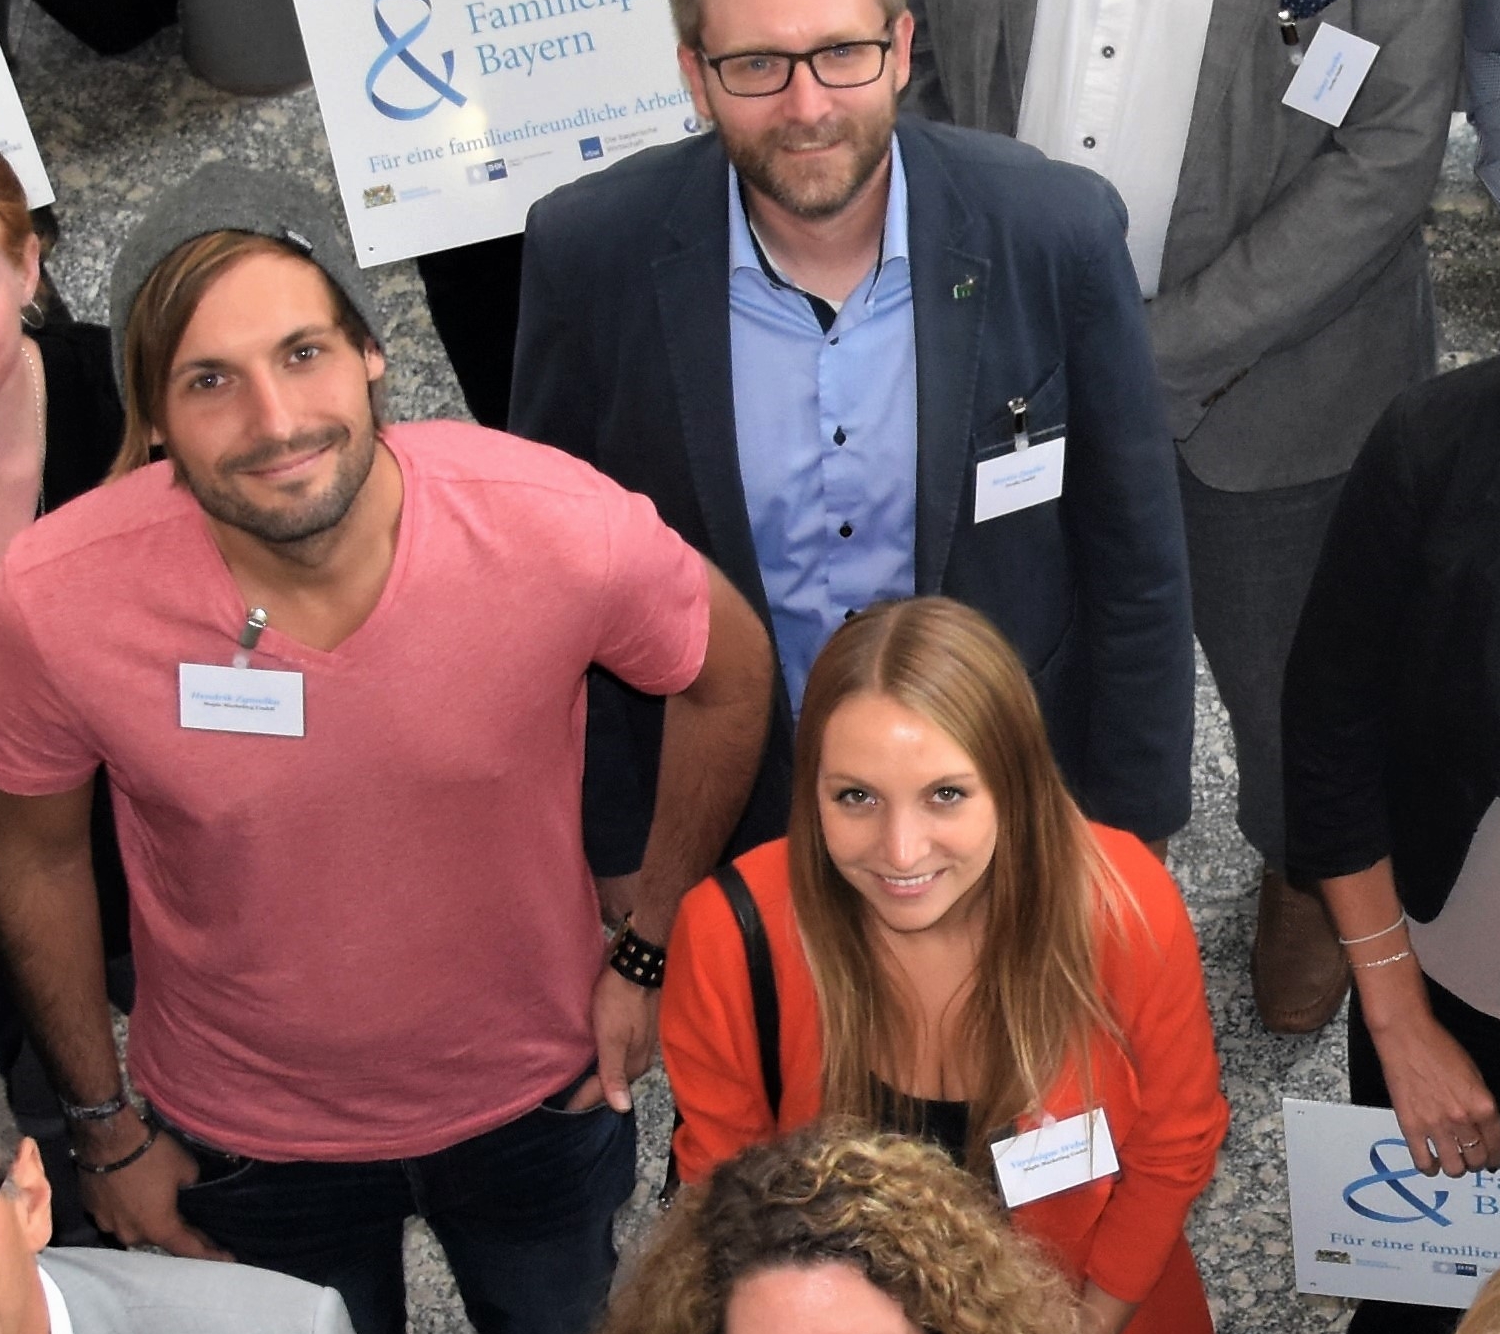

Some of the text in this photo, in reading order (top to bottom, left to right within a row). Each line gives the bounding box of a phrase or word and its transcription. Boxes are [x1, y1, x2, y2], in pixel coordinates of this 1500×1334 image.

[475, 31, 596, 77] Bayern
[368, 88, 693, 174] Für eine familienfreundliche Arbeit
[1330, 1232, 1365, 1246] Für
[1371, 1238, 1414, 1251] eine
